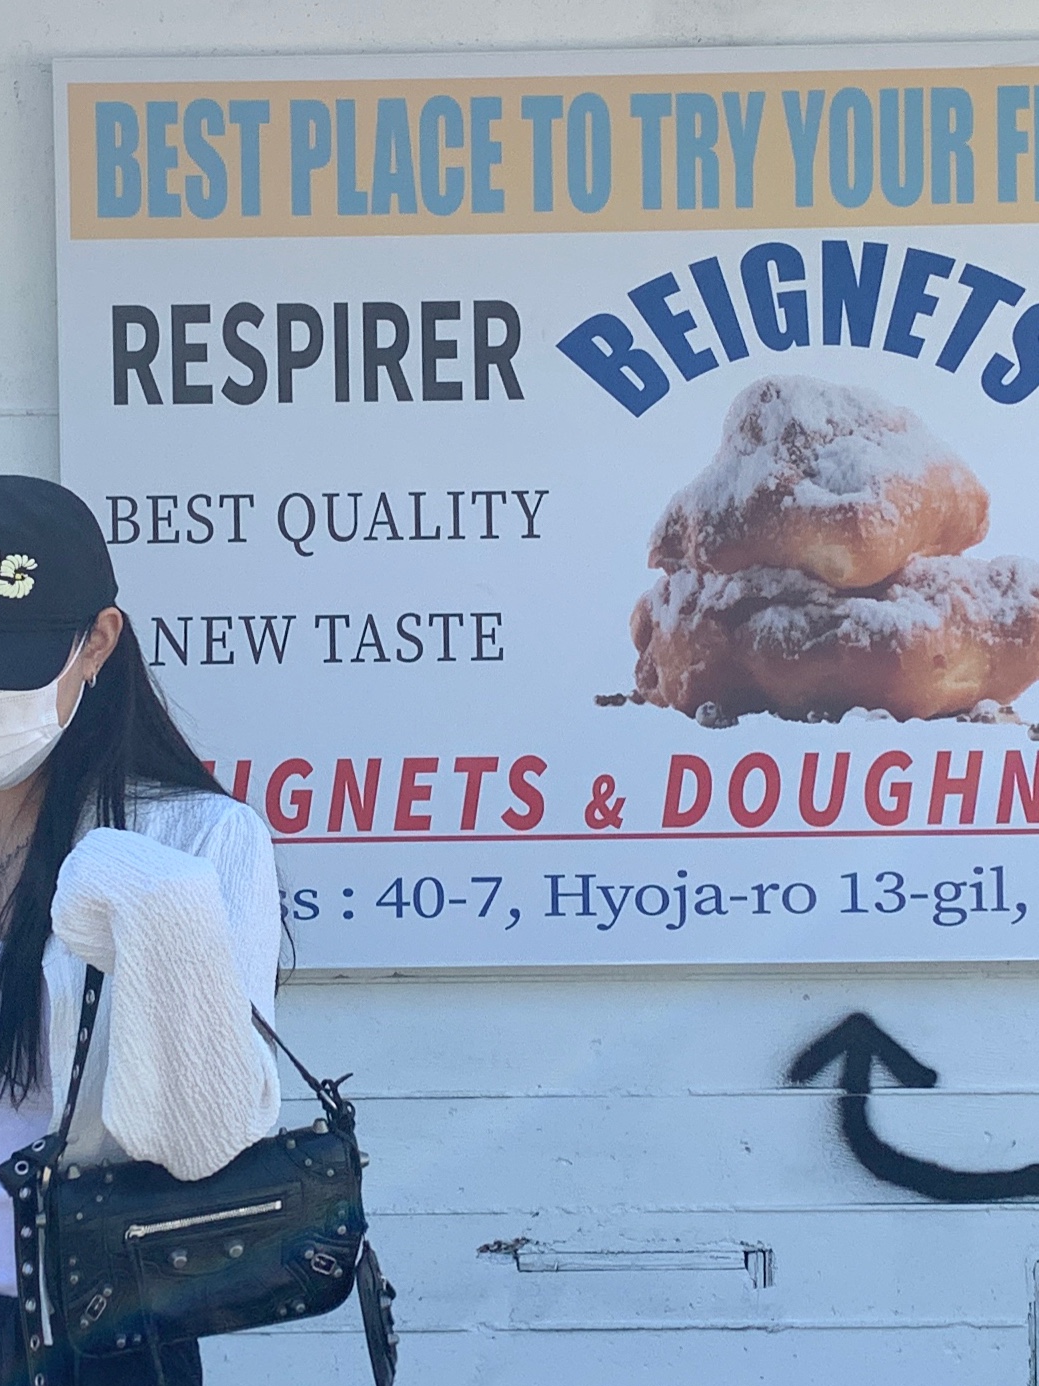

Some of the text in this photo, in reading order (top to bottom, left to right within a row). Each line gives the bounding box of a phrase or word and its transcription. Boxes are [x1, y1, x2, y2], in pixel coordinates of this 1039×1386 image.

[96, 85, 1039, 219] BEST PLACE TO TRY YOUR F
[112, 300, 525, 405] RESPIRER
[556, 239, 1039, 418] BEIGNETS
[106, 490, 550, 557] BEST QUALITY
[149, 612, 504, 667] NEW TASTE
[585, 774, 625, 829] &
[662, 750, 1039, 829] DOUGHN
[375, 876, 521, 931] 40-7,
[544, 870, 817, 931] Hyoja-ro
[840, 865, 1028, 927] 13-gil,
